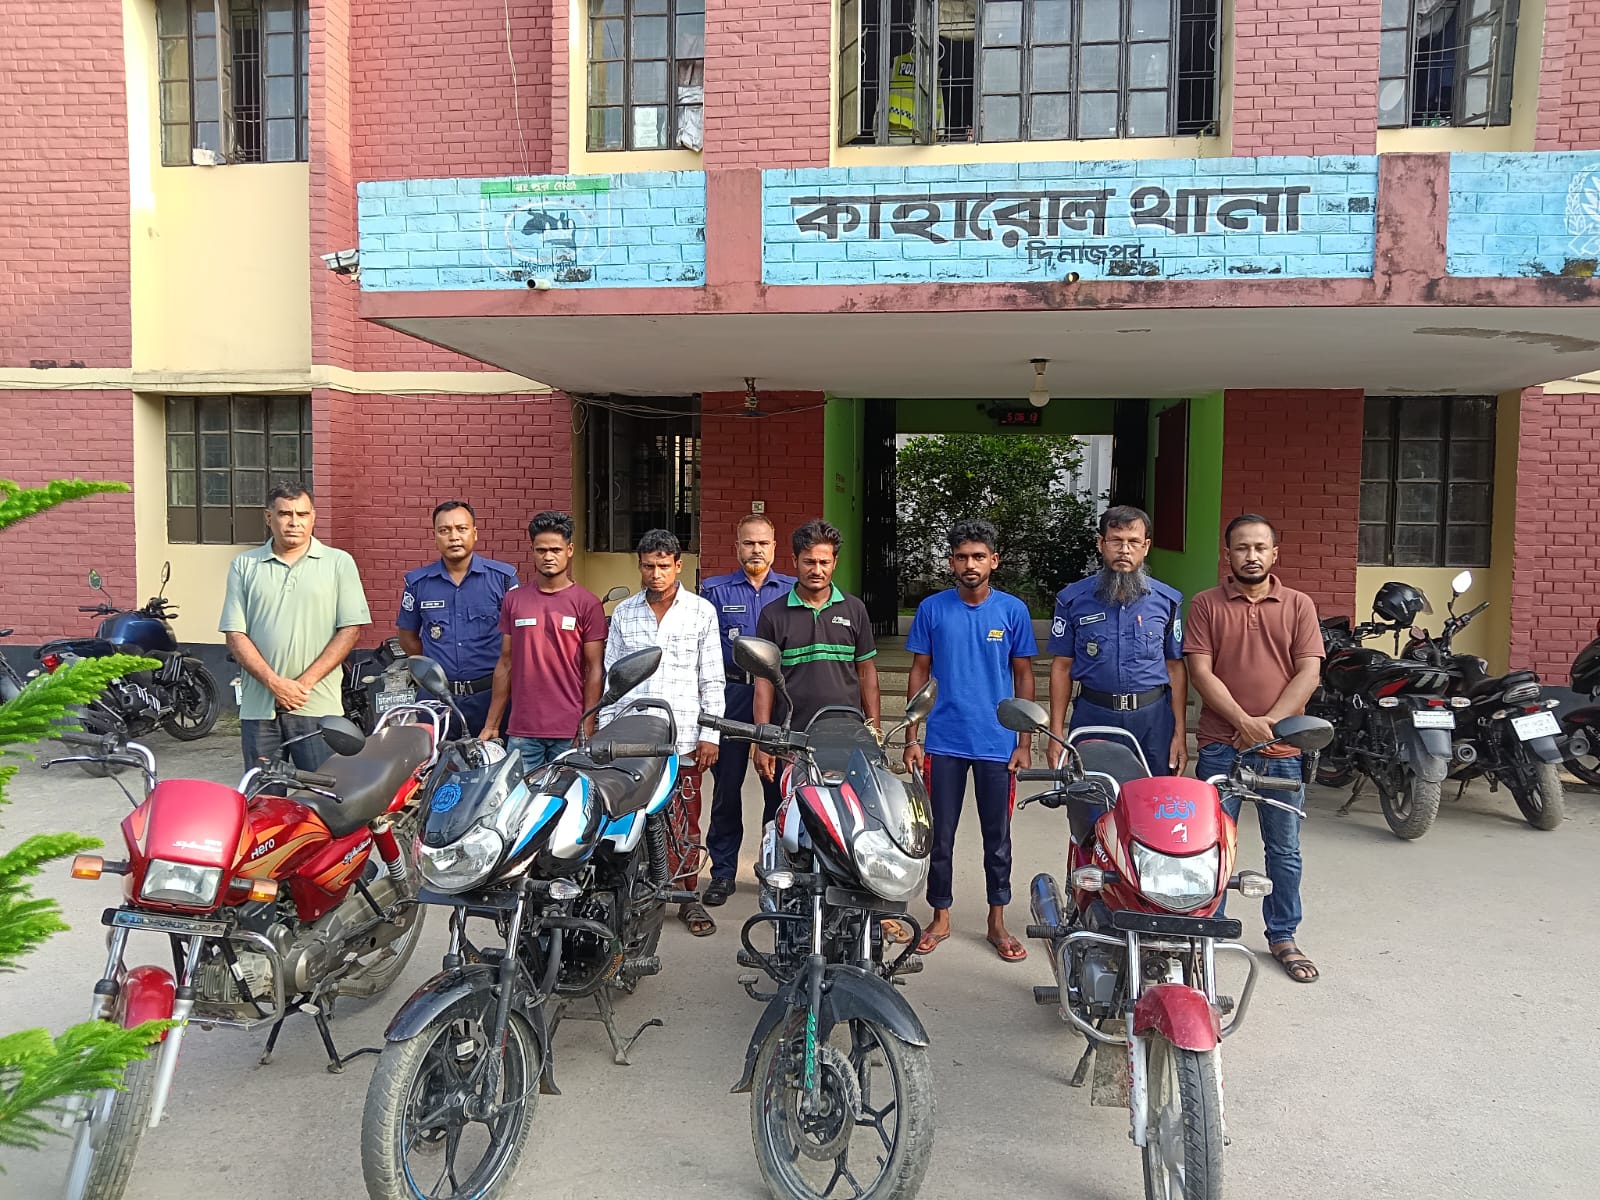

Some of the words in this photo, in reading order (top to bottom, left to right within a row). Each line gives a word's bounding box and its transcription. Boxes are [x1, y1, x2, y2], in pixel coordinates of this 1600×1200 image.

[790, 189, 1116, 247] কাহারোল
[1130, 186, 1311, 235] থানা
[1025, 240, 1145, 266] দিনাজপর
[251, 838, 276, 860] Hero
